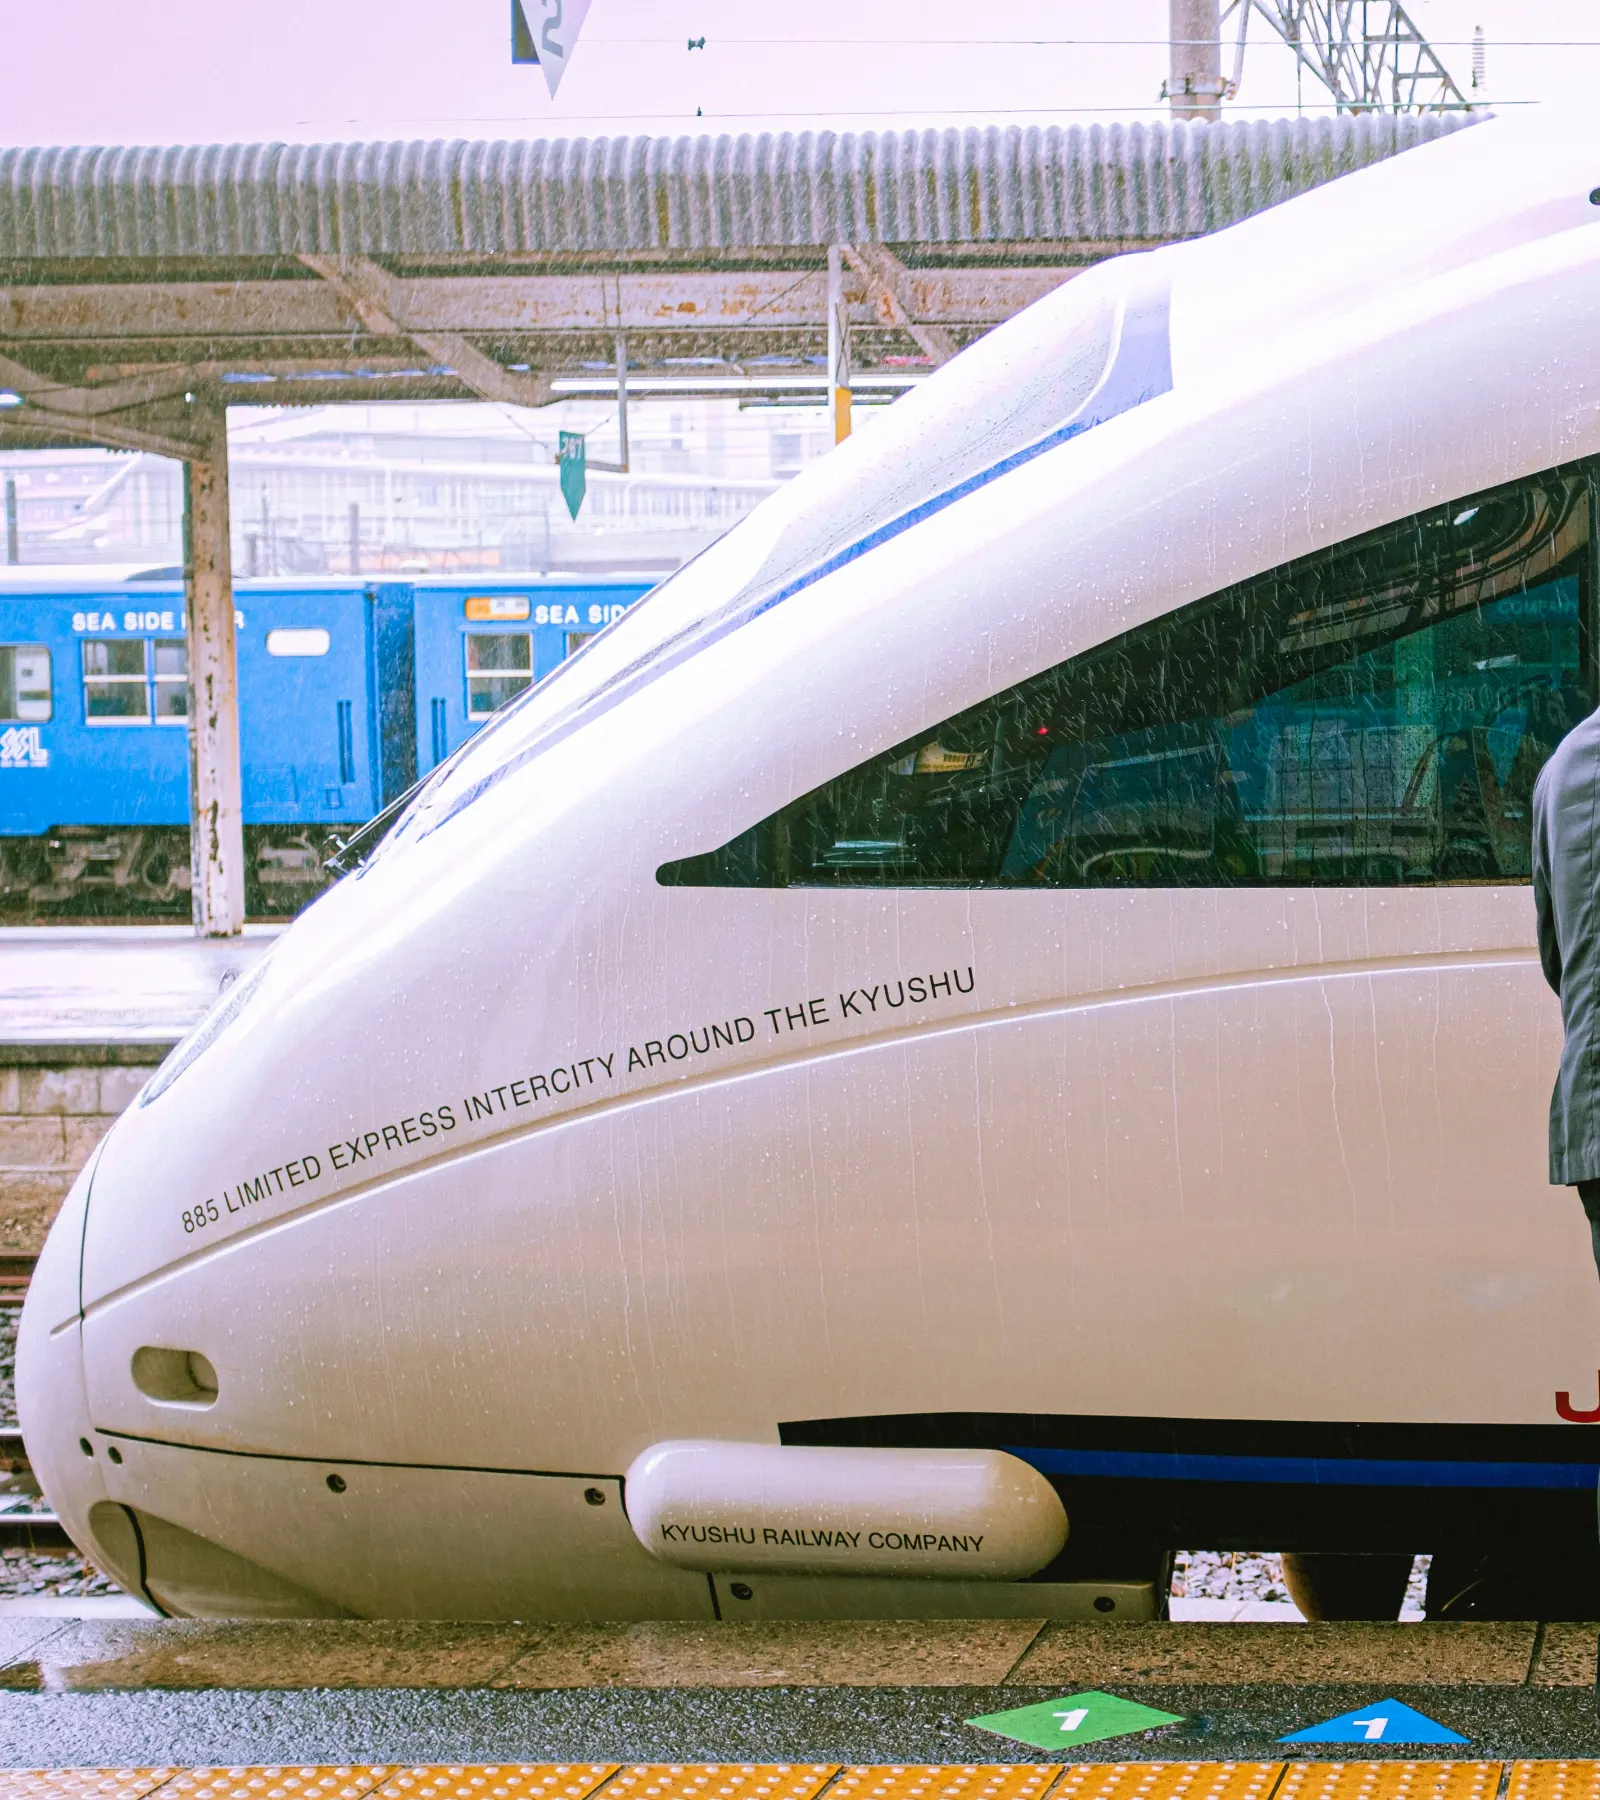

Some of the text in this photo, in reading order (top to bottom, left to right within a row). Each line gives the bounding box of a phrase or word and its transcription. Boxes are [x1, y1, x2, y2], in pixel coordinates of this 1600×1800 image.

[72, 612, 116, 631] SEA
[124, 611, 174, 631] SIDE
[535, 605, 580, 624] SEA
[588, 604, 633, 624] SID
[181, 966, 976, 1235] 885 LIMITED EXPRESS INTERCITY AROUND THE KYUSHU
[661, 1524, 984, 1553] KYUSHU RAILWAY COMPANY
[1051, 1708, 1089, 1731] 1
[1352, 1717, 1388, 1739] 1
